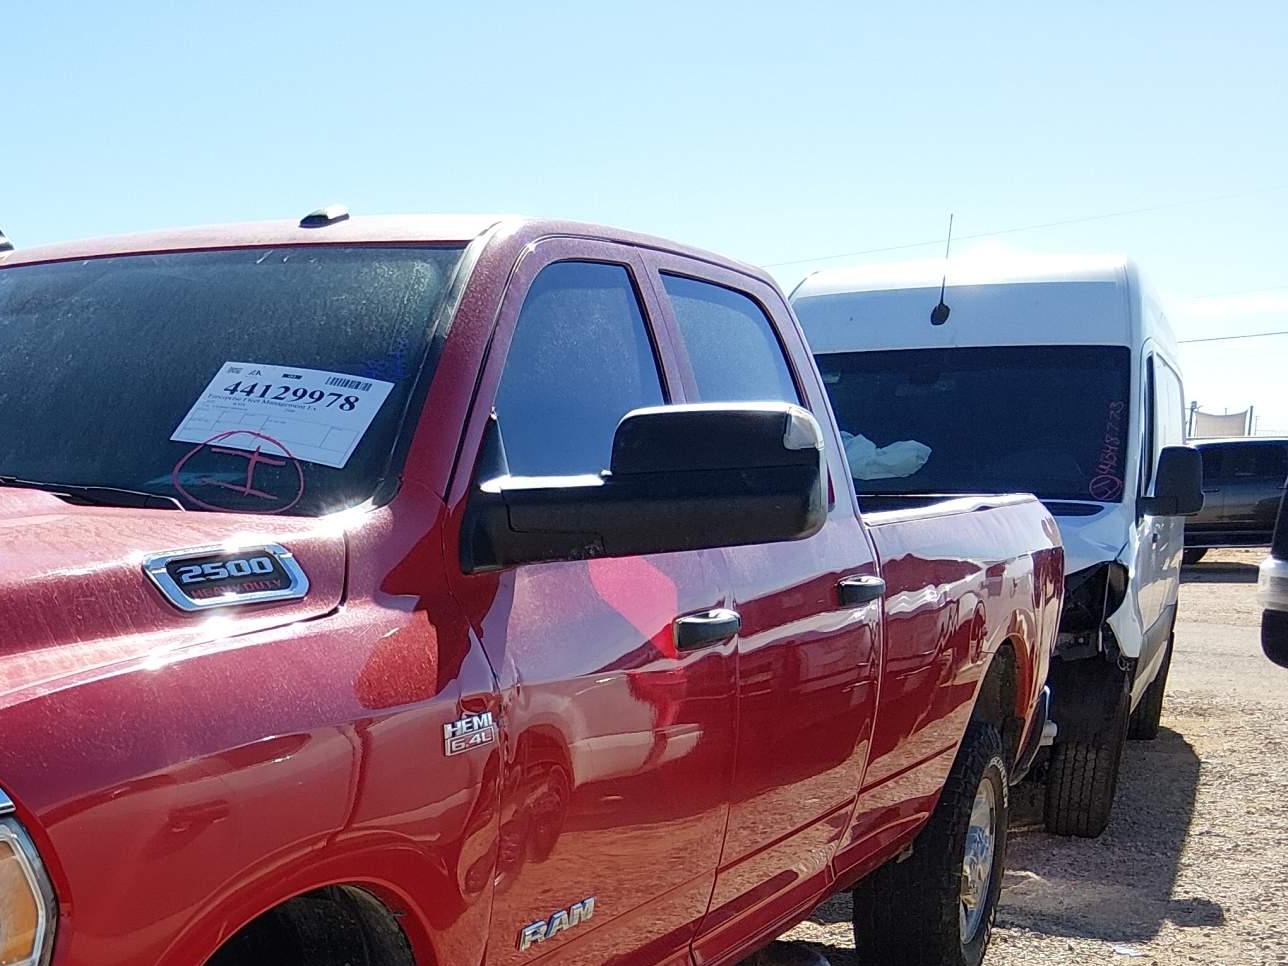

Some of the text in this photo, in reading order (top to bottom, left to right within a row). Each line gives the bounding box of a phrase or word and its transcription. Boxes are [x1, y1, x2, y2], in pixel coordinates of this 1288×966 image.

[223, 381, 360, 411] 44129978
[176, 556, 274, 583] 2500
[190, 579, 281, 599] HEAVY DUTY
[443, 711, 493, 740] HEMI
[451, 732, 492, 752] 6.4L
[518, 896, 595, 952] RAM
